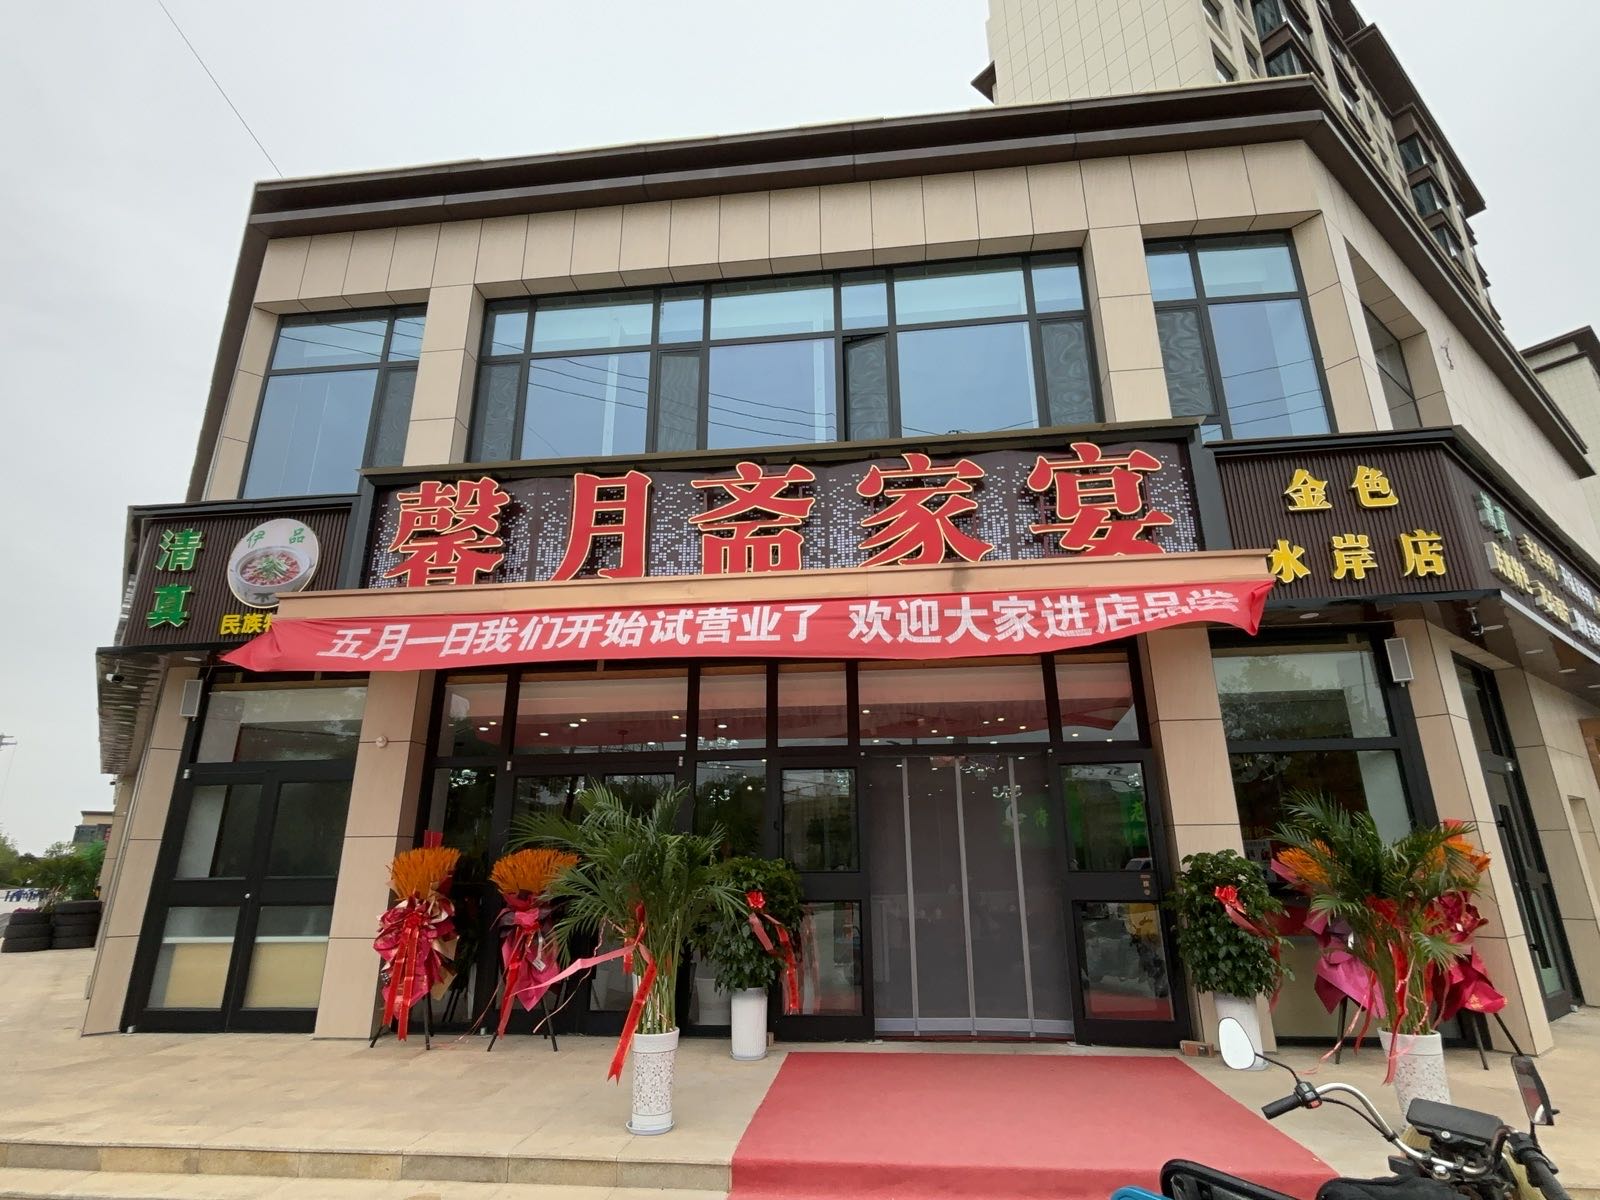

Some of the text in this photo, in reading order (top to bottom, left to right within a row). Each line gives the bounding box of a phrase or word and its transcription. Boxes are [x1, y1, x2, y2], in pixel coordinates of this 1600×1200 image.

[384, 441, 1174, 588] 馨月斋家宴
[1284, 465, 1399, 512] 金色
[246, 527, 305, 548] 伊品
[1267, 529, 1447, 584] 水岸店
[146, 528, 203, 629] 清真
[316, 603, 822, 662] 五月一日我们开始试营业了
[848, 589, 1240, 645] 欢迎大家进店品尝
